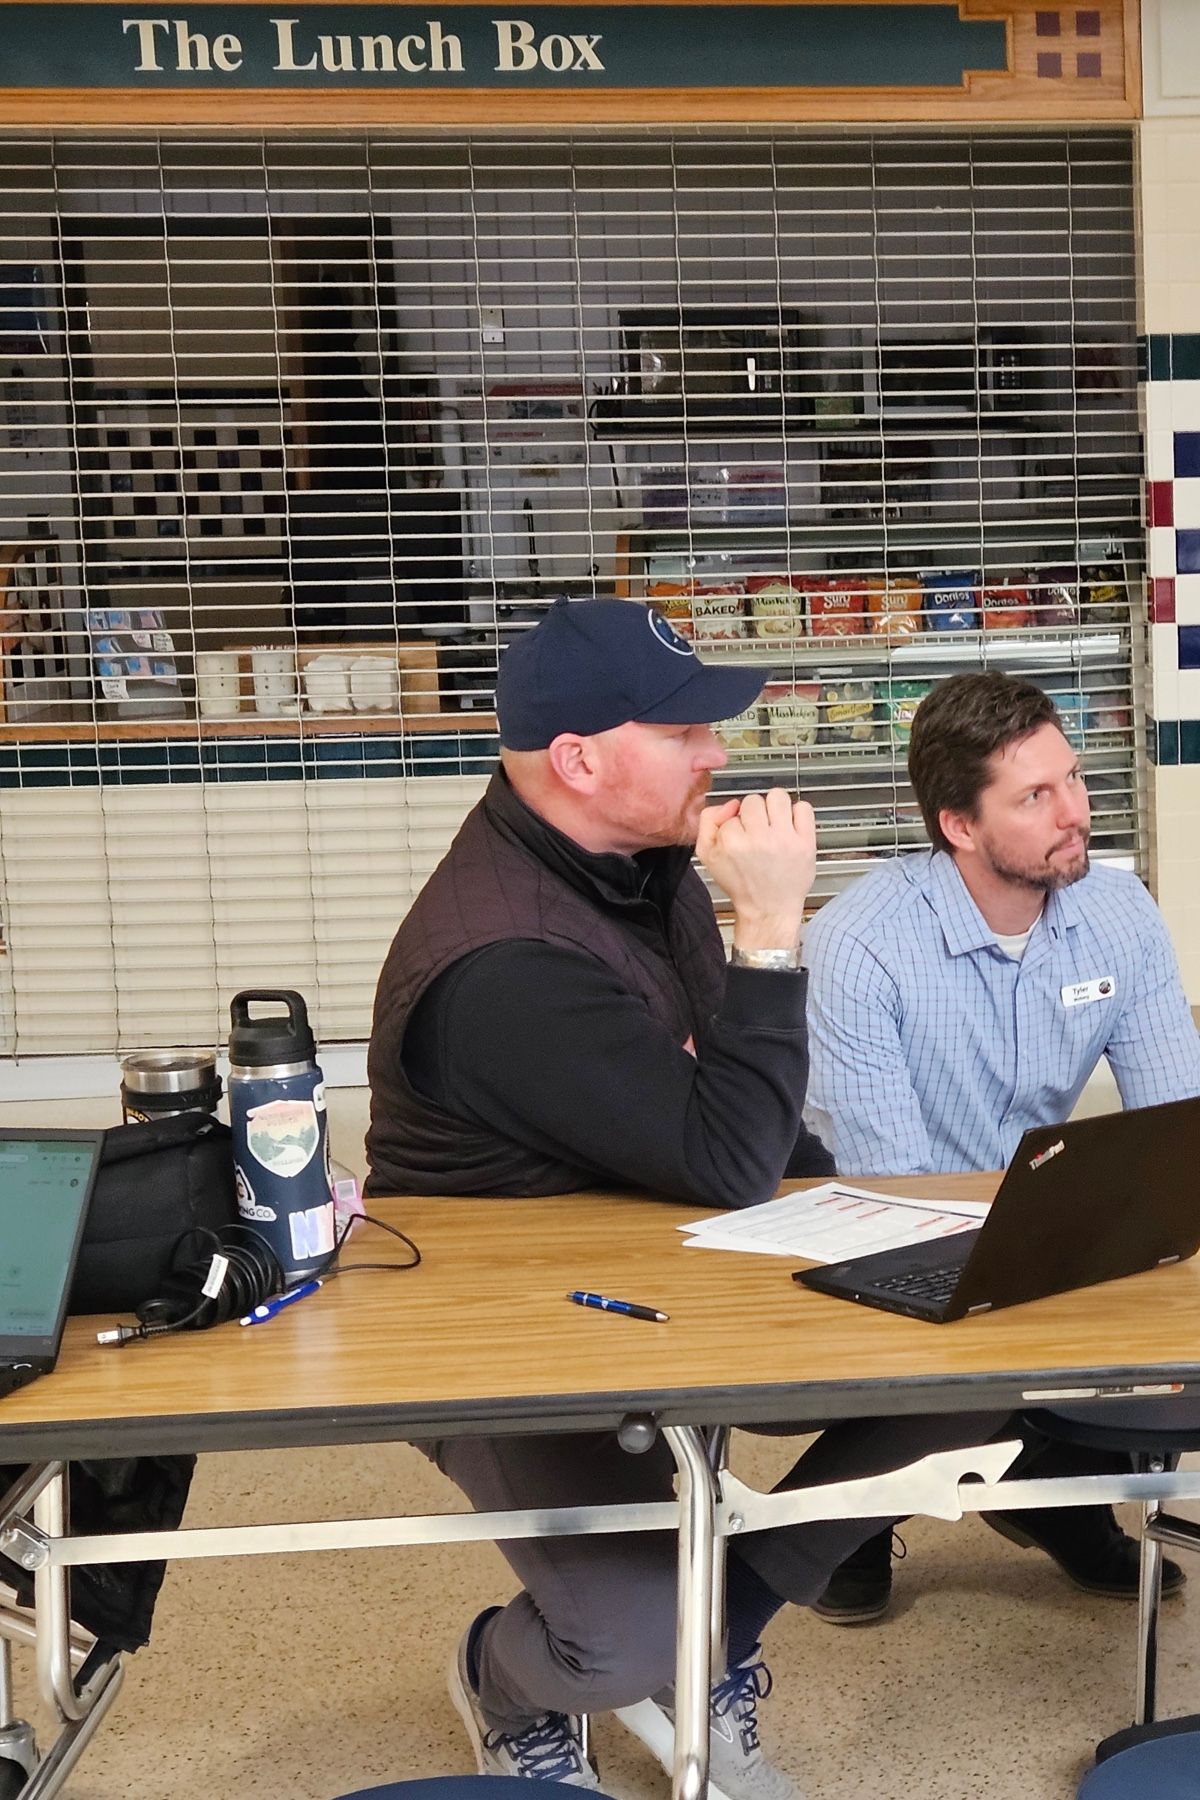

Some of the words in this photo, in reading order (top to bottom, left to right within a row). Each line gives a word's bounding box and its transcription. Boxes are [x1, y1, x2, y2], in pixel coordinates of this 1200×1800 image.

[122, 18, 243, 71] The
[269, 18, 465, 72] Lunch
[491, 19, 605, 71] Box
[934, 591, 970, 605] Doritos
[695, 605, 737, 617] BAKED
